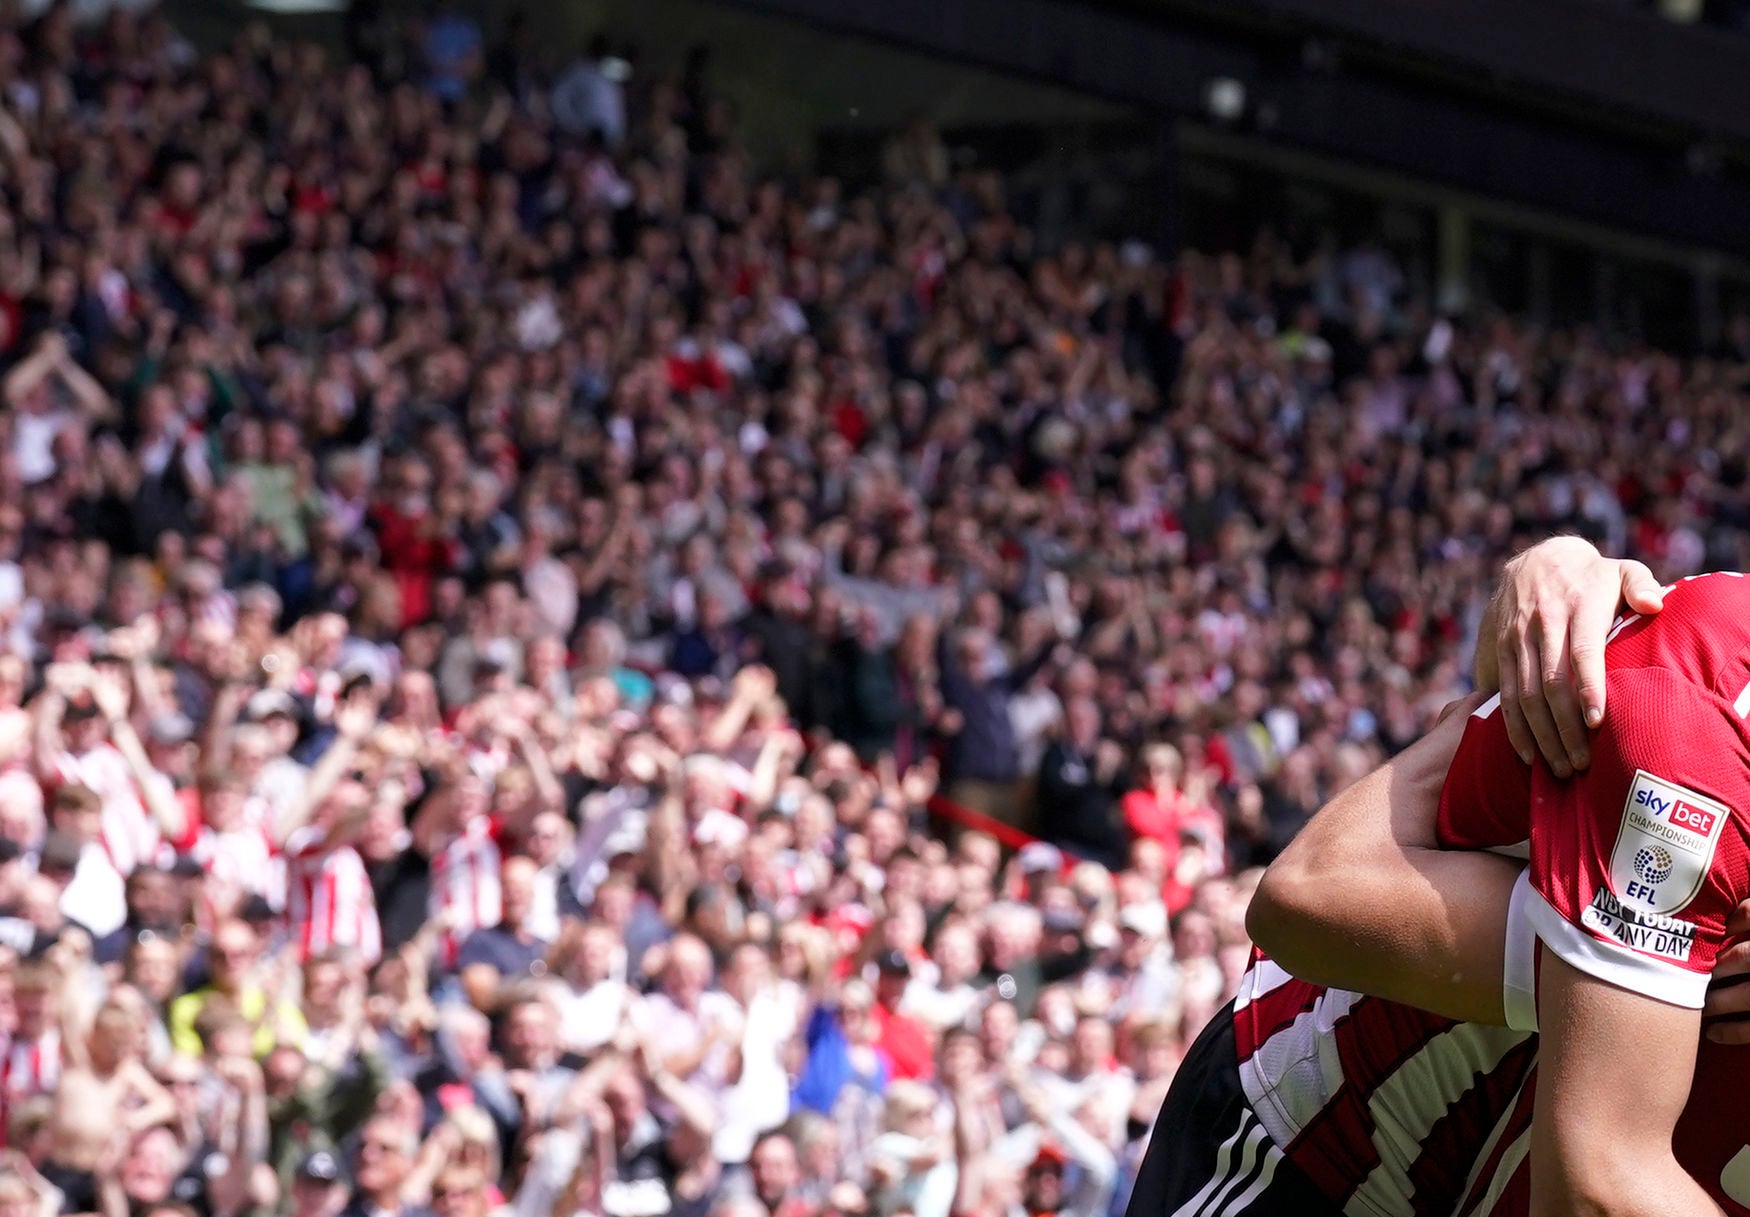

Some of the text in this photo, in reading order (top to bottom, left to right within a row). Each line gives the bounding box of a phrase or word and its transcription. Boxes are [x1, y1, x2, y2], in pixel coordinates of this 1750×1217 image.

[1635, 789, 1712, 832] sky bet
[1629, 811, 1707, 850] CHAMPIONSHIP
[1626, 880, 1656, 906] EFL
[1613, 921, 1652, 948] ANY
[1654, 933, 1690, 957] DAY
